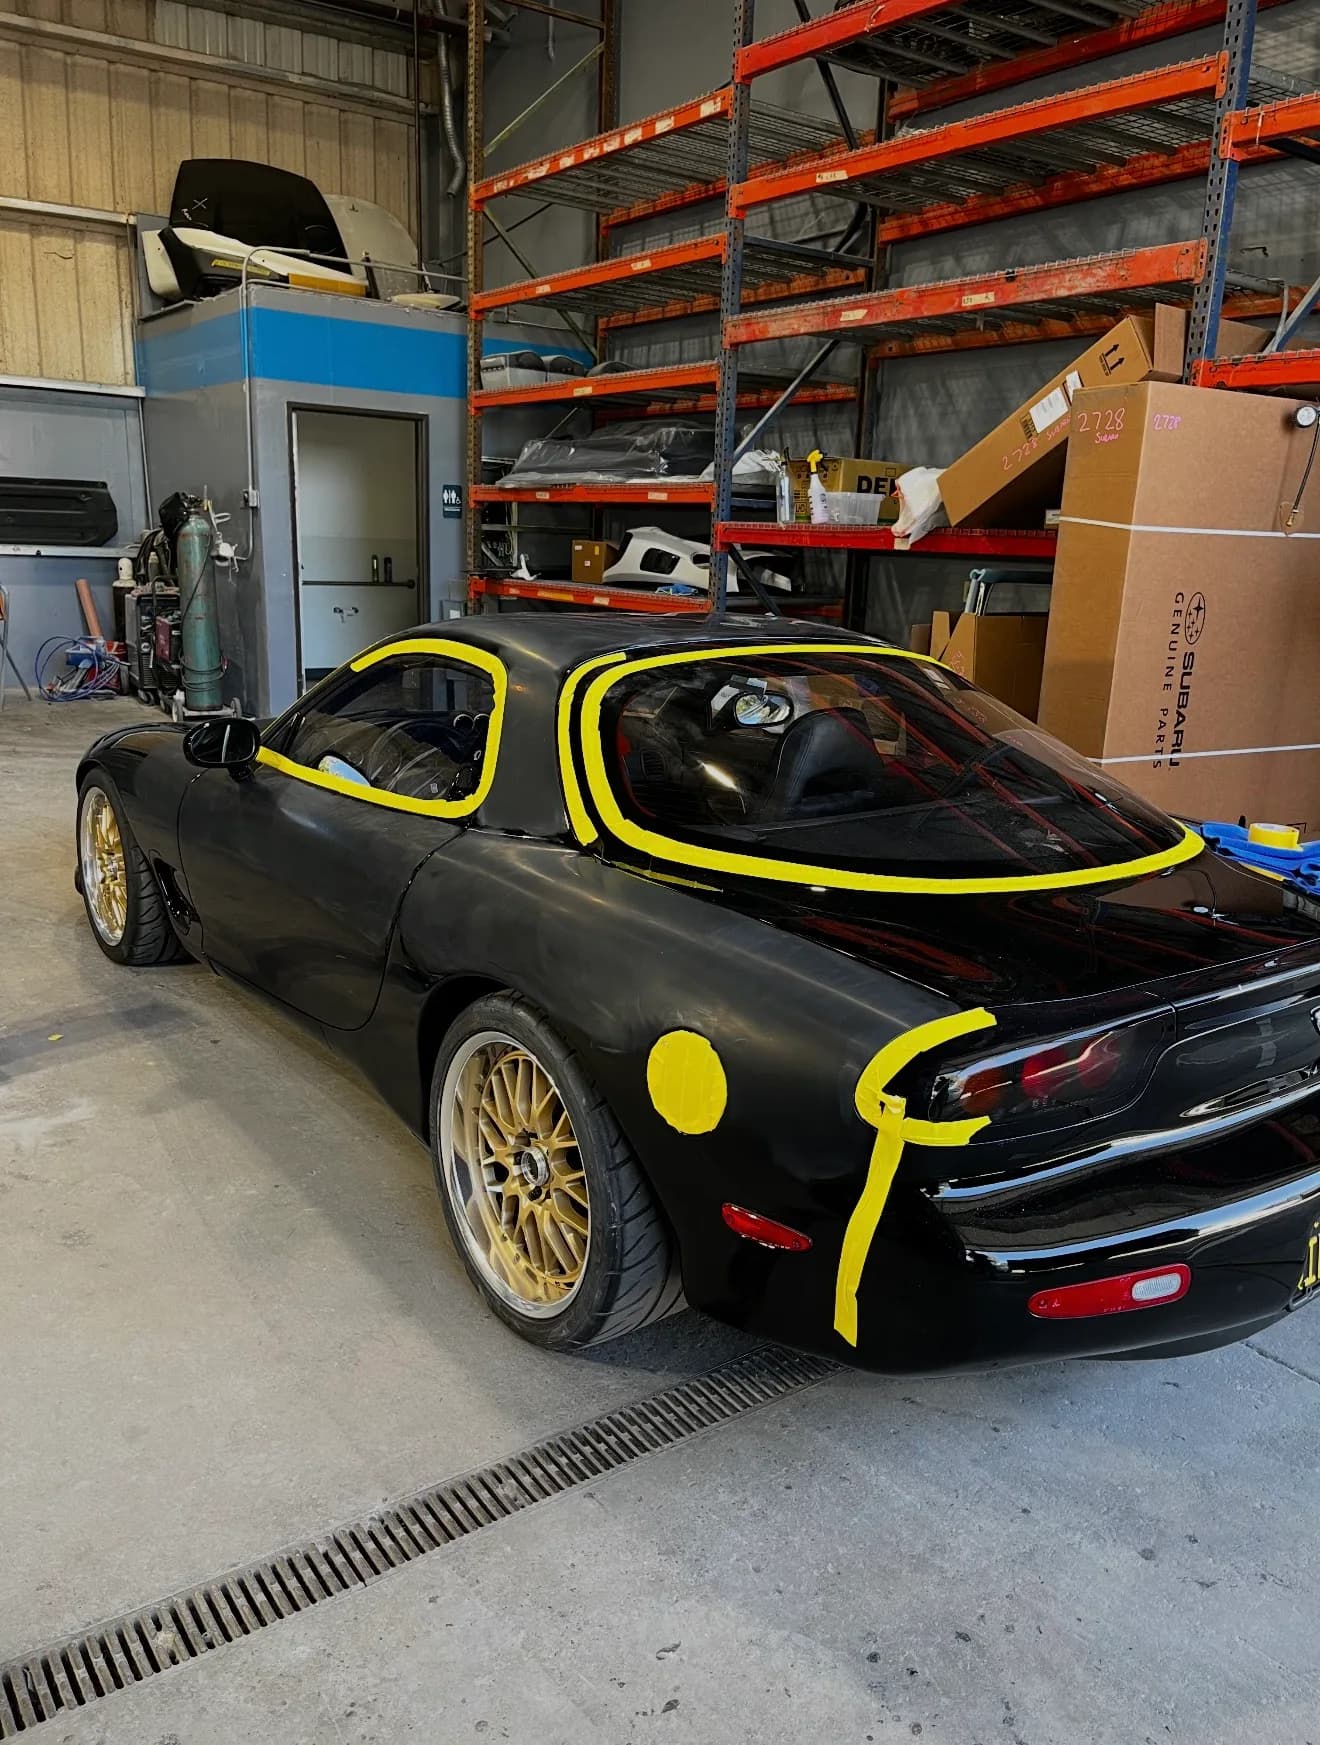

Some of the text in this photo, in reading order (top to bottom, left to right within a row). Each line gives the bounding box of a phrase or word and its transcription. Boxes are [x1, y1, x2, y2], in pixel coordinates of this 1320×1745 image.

[1001, 436, 1039, 471] 2728
[1077, 407, 1126, 433] 2728
[1152, 591, 1185, 769] GENUINE PARTS
[1168, 651, 1195, 767] SUBARU
